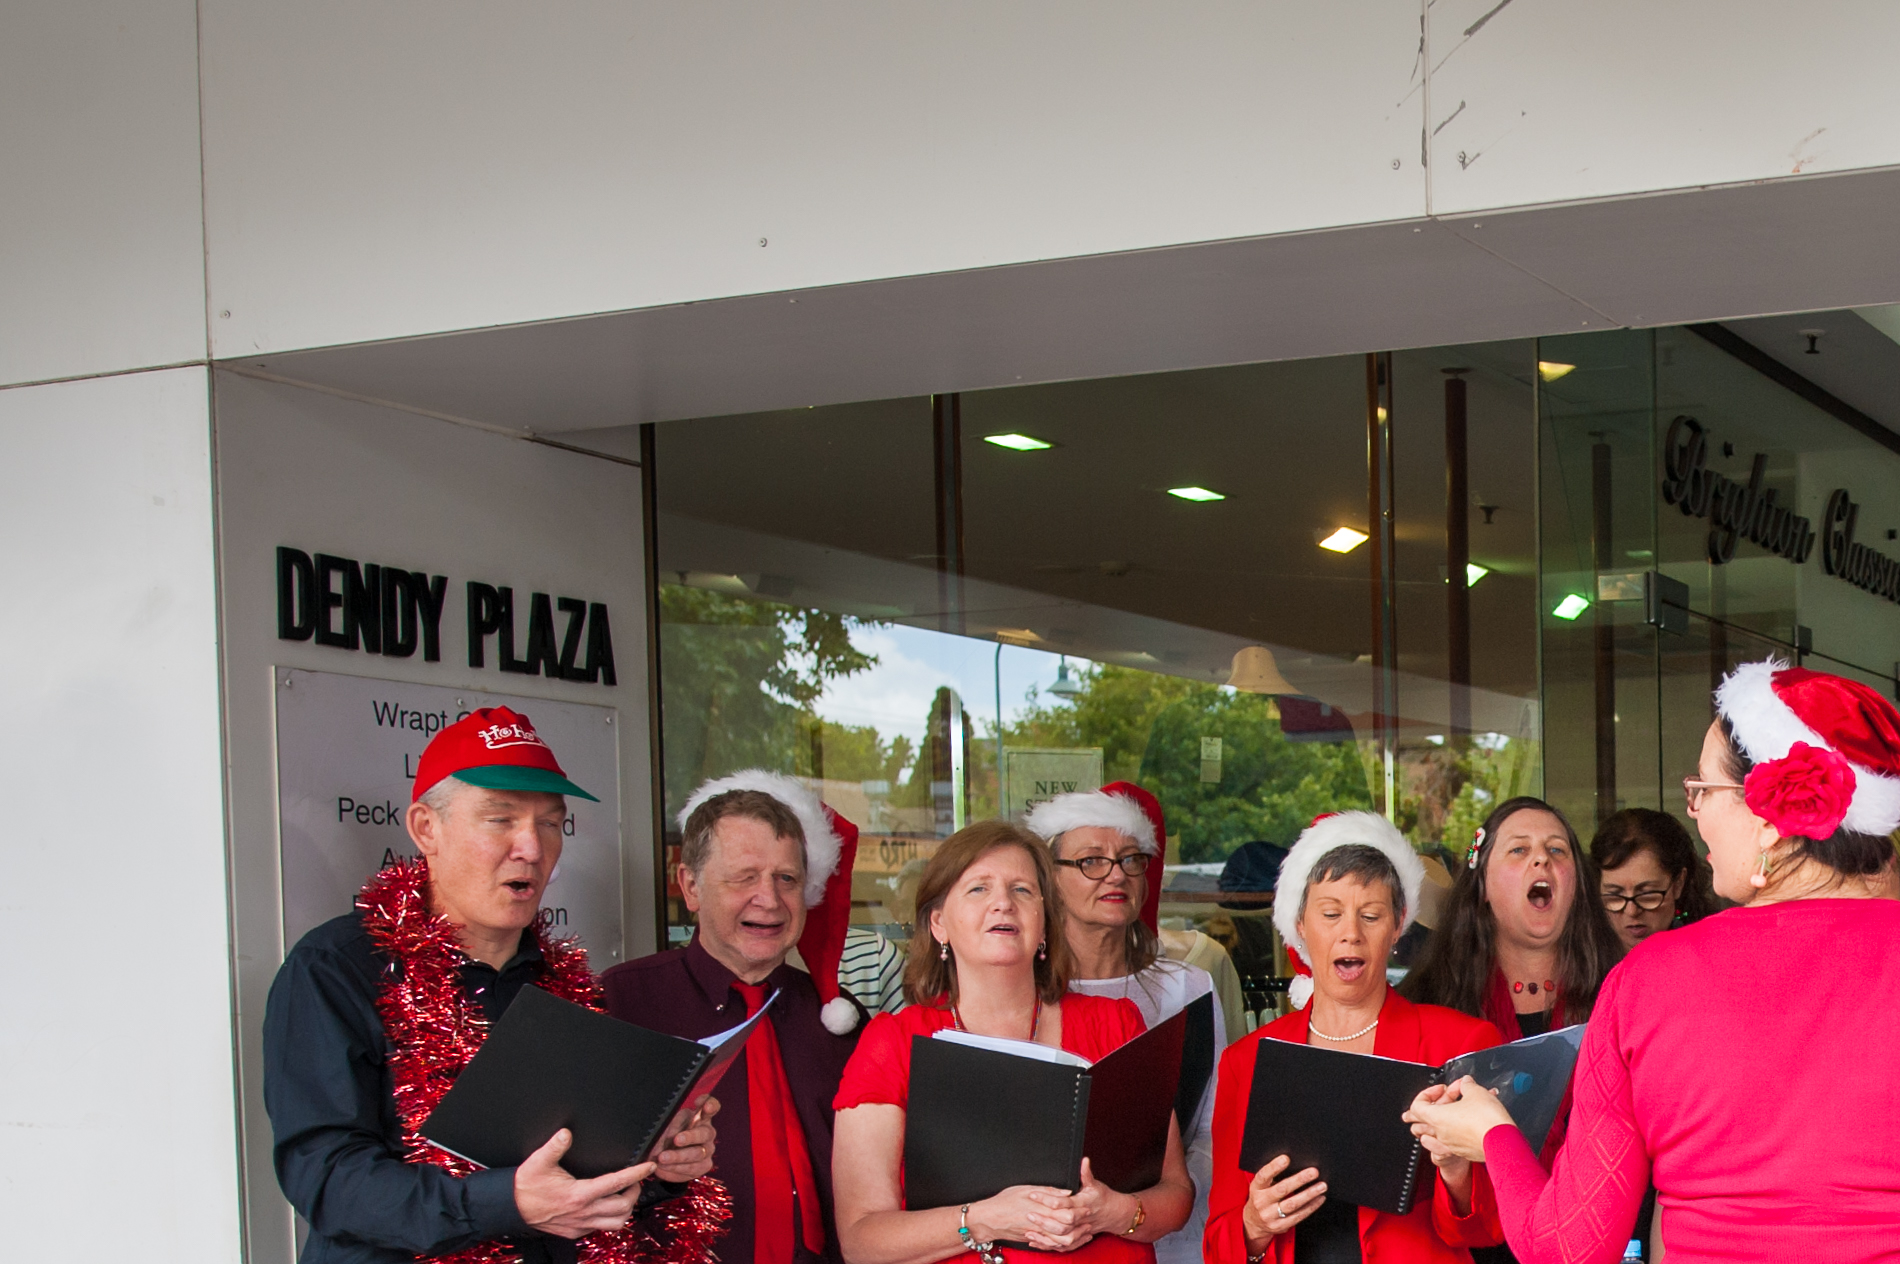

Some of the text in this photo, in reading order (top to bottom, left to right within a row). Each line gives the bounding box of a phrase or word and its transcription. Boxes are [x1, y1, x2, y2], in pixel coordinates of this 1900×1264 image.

[1662, 415, 1815, 564] Brighton
[276, 546, 617, 686] DENDY PLAZA
[373, 700, 448, 738] Wrapt
[1034, 780, 1079, 796] NEW
[338, 796, 400, 827] Peck
